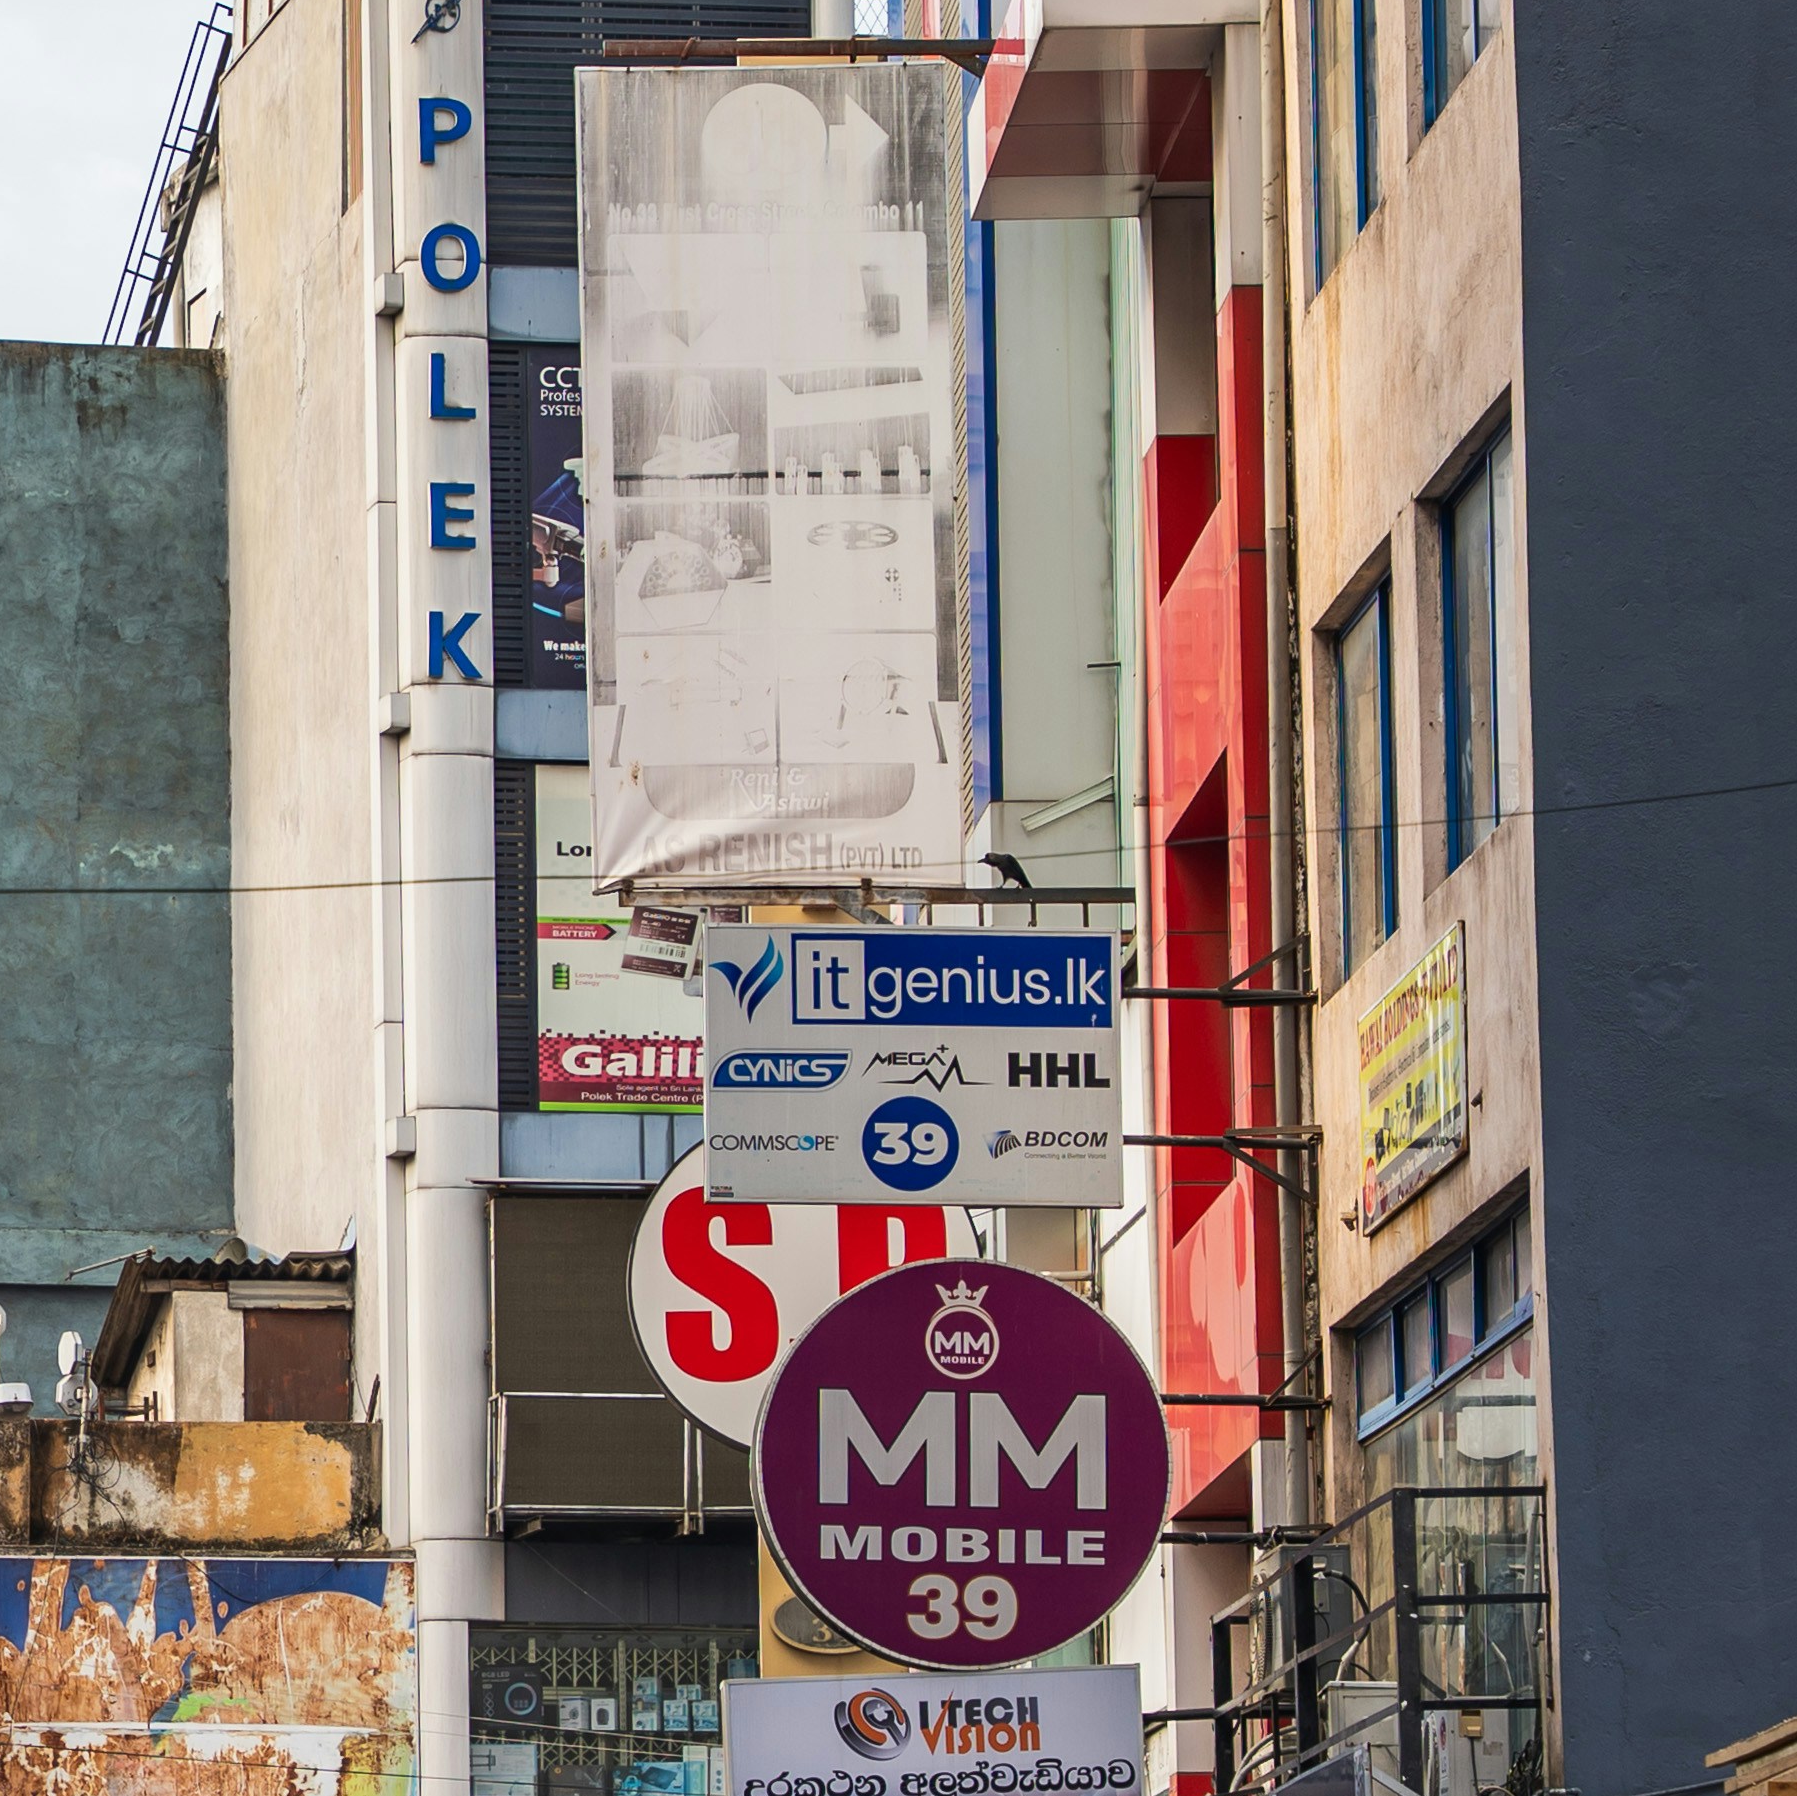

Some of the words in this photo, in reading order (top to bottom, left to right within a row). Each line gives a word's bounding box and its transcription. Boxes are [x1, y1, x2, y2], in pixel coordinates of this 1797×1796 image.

[418, 96, 482, 681] POLEK
[544, 640, 558, 651] We
[698, 832, 833, 872] RENISH
[840, 842, 884, 870] (PVT)
[891, 847, 923, 869] LTD
[552, 930, 598, 939] BATTERY
[1007, 1052, 1111, 1088] HHL
[616, 1092, 647, 1101] Trade
[652, 1093, 688, 1102] Centre
[873, 1122, 950, 1166] 39
[1025, 1130, 1108, 1148] BDCOM
[935, 1330, 991, 1354] MM
[940, 1356, 985, 1366] MOBILE
[819, 1388, 1106, 1510] MM
[819, 1524, 1106, 1566] MOBILE
[906, 1574, 1018, 1641] 39
